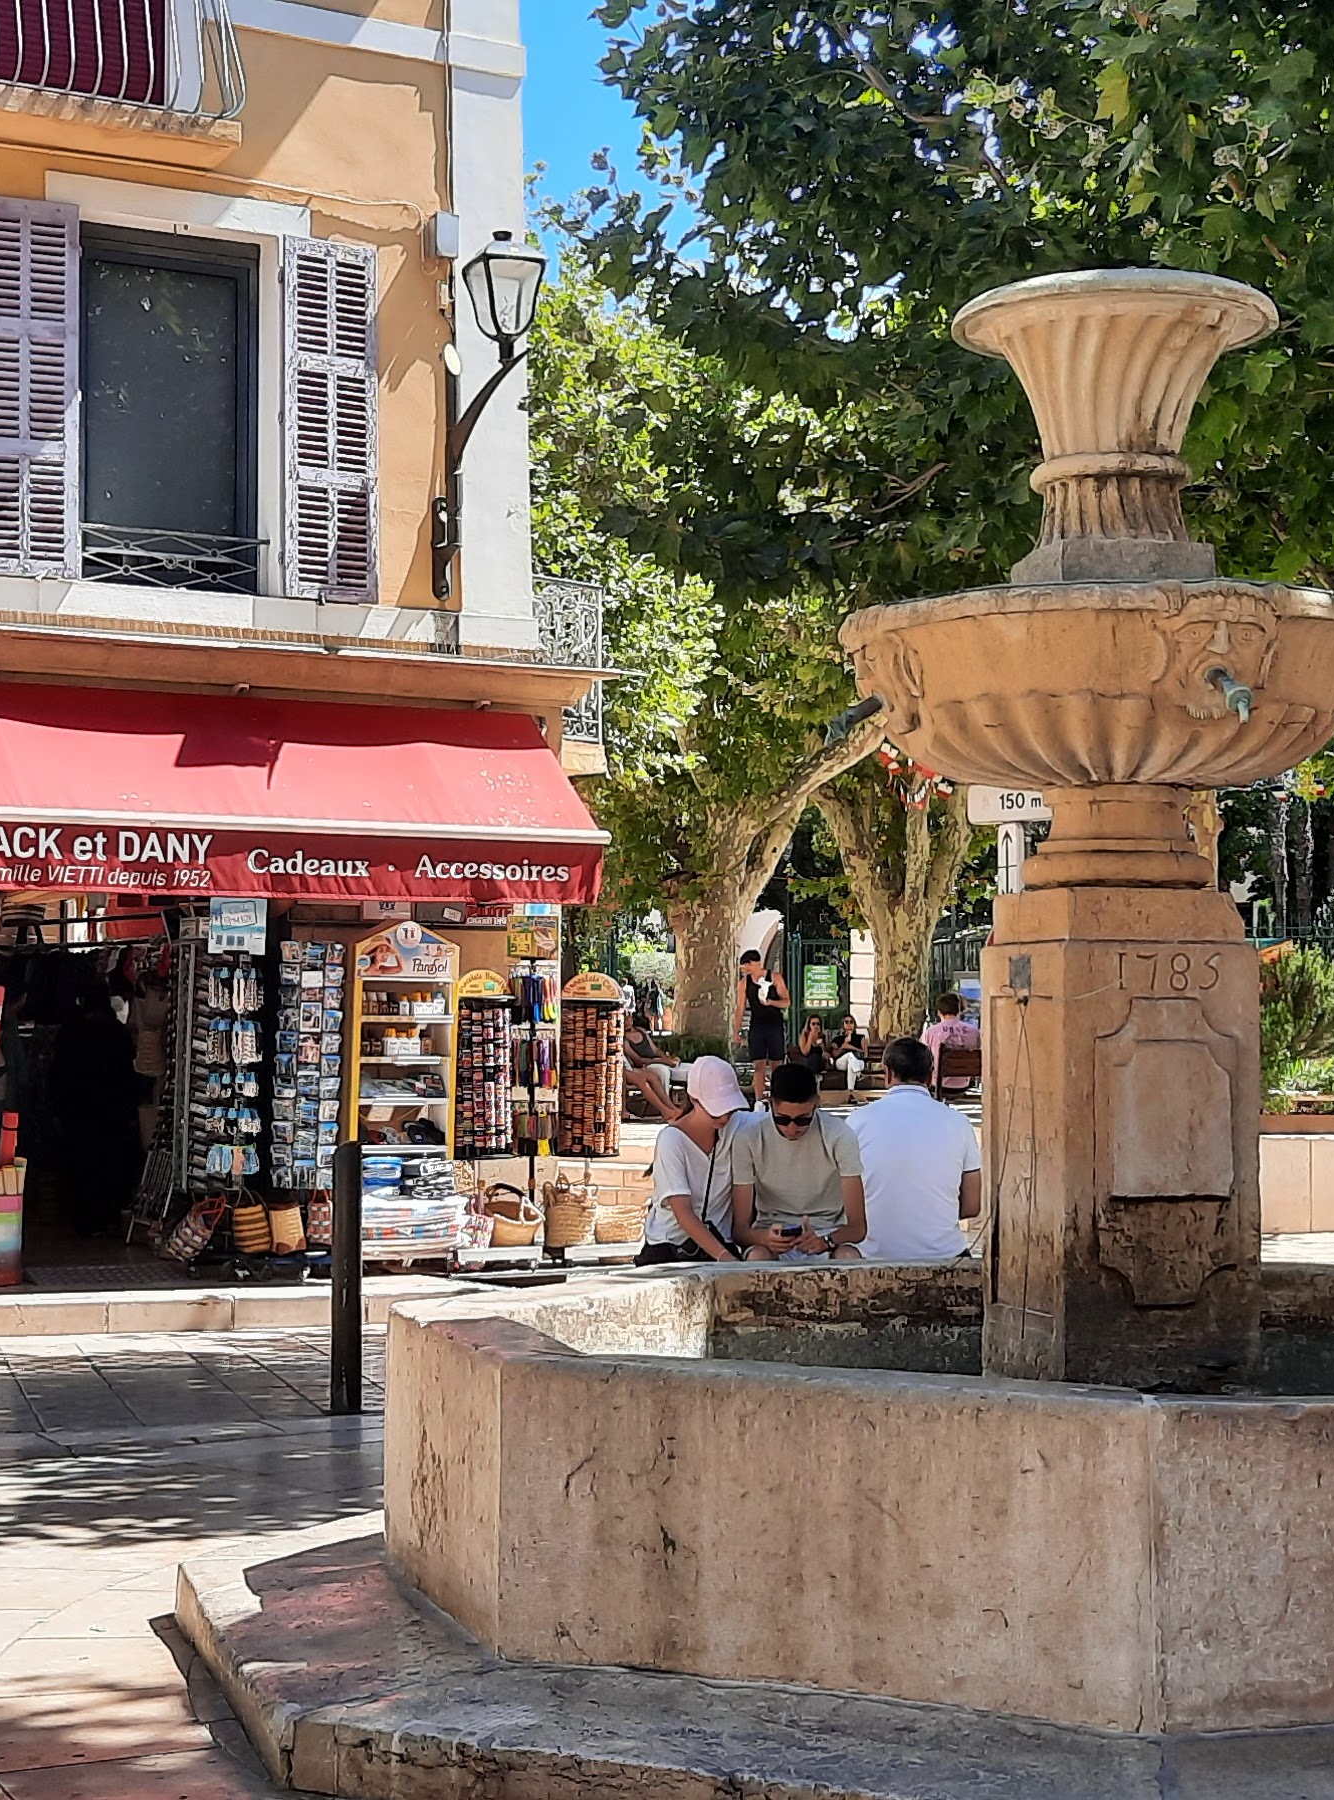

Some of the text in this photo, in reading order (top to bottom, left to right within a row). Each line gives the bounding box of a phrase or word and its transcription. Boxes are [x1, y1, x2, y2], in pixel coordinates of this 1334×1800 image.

[999, 792, 1042, 810] 150 m
[73, 834, 108, 862] et
[118, 831, 213, 865] DANY
[48, 865, 104, 885] VIETTI
[107, 867, 167, 889] depuis
[173, 869, 211, 887] 1952
[246, 848, 569, 883] Cadeaux Accessoires
[1116, 951, 1222, 991] 1785
